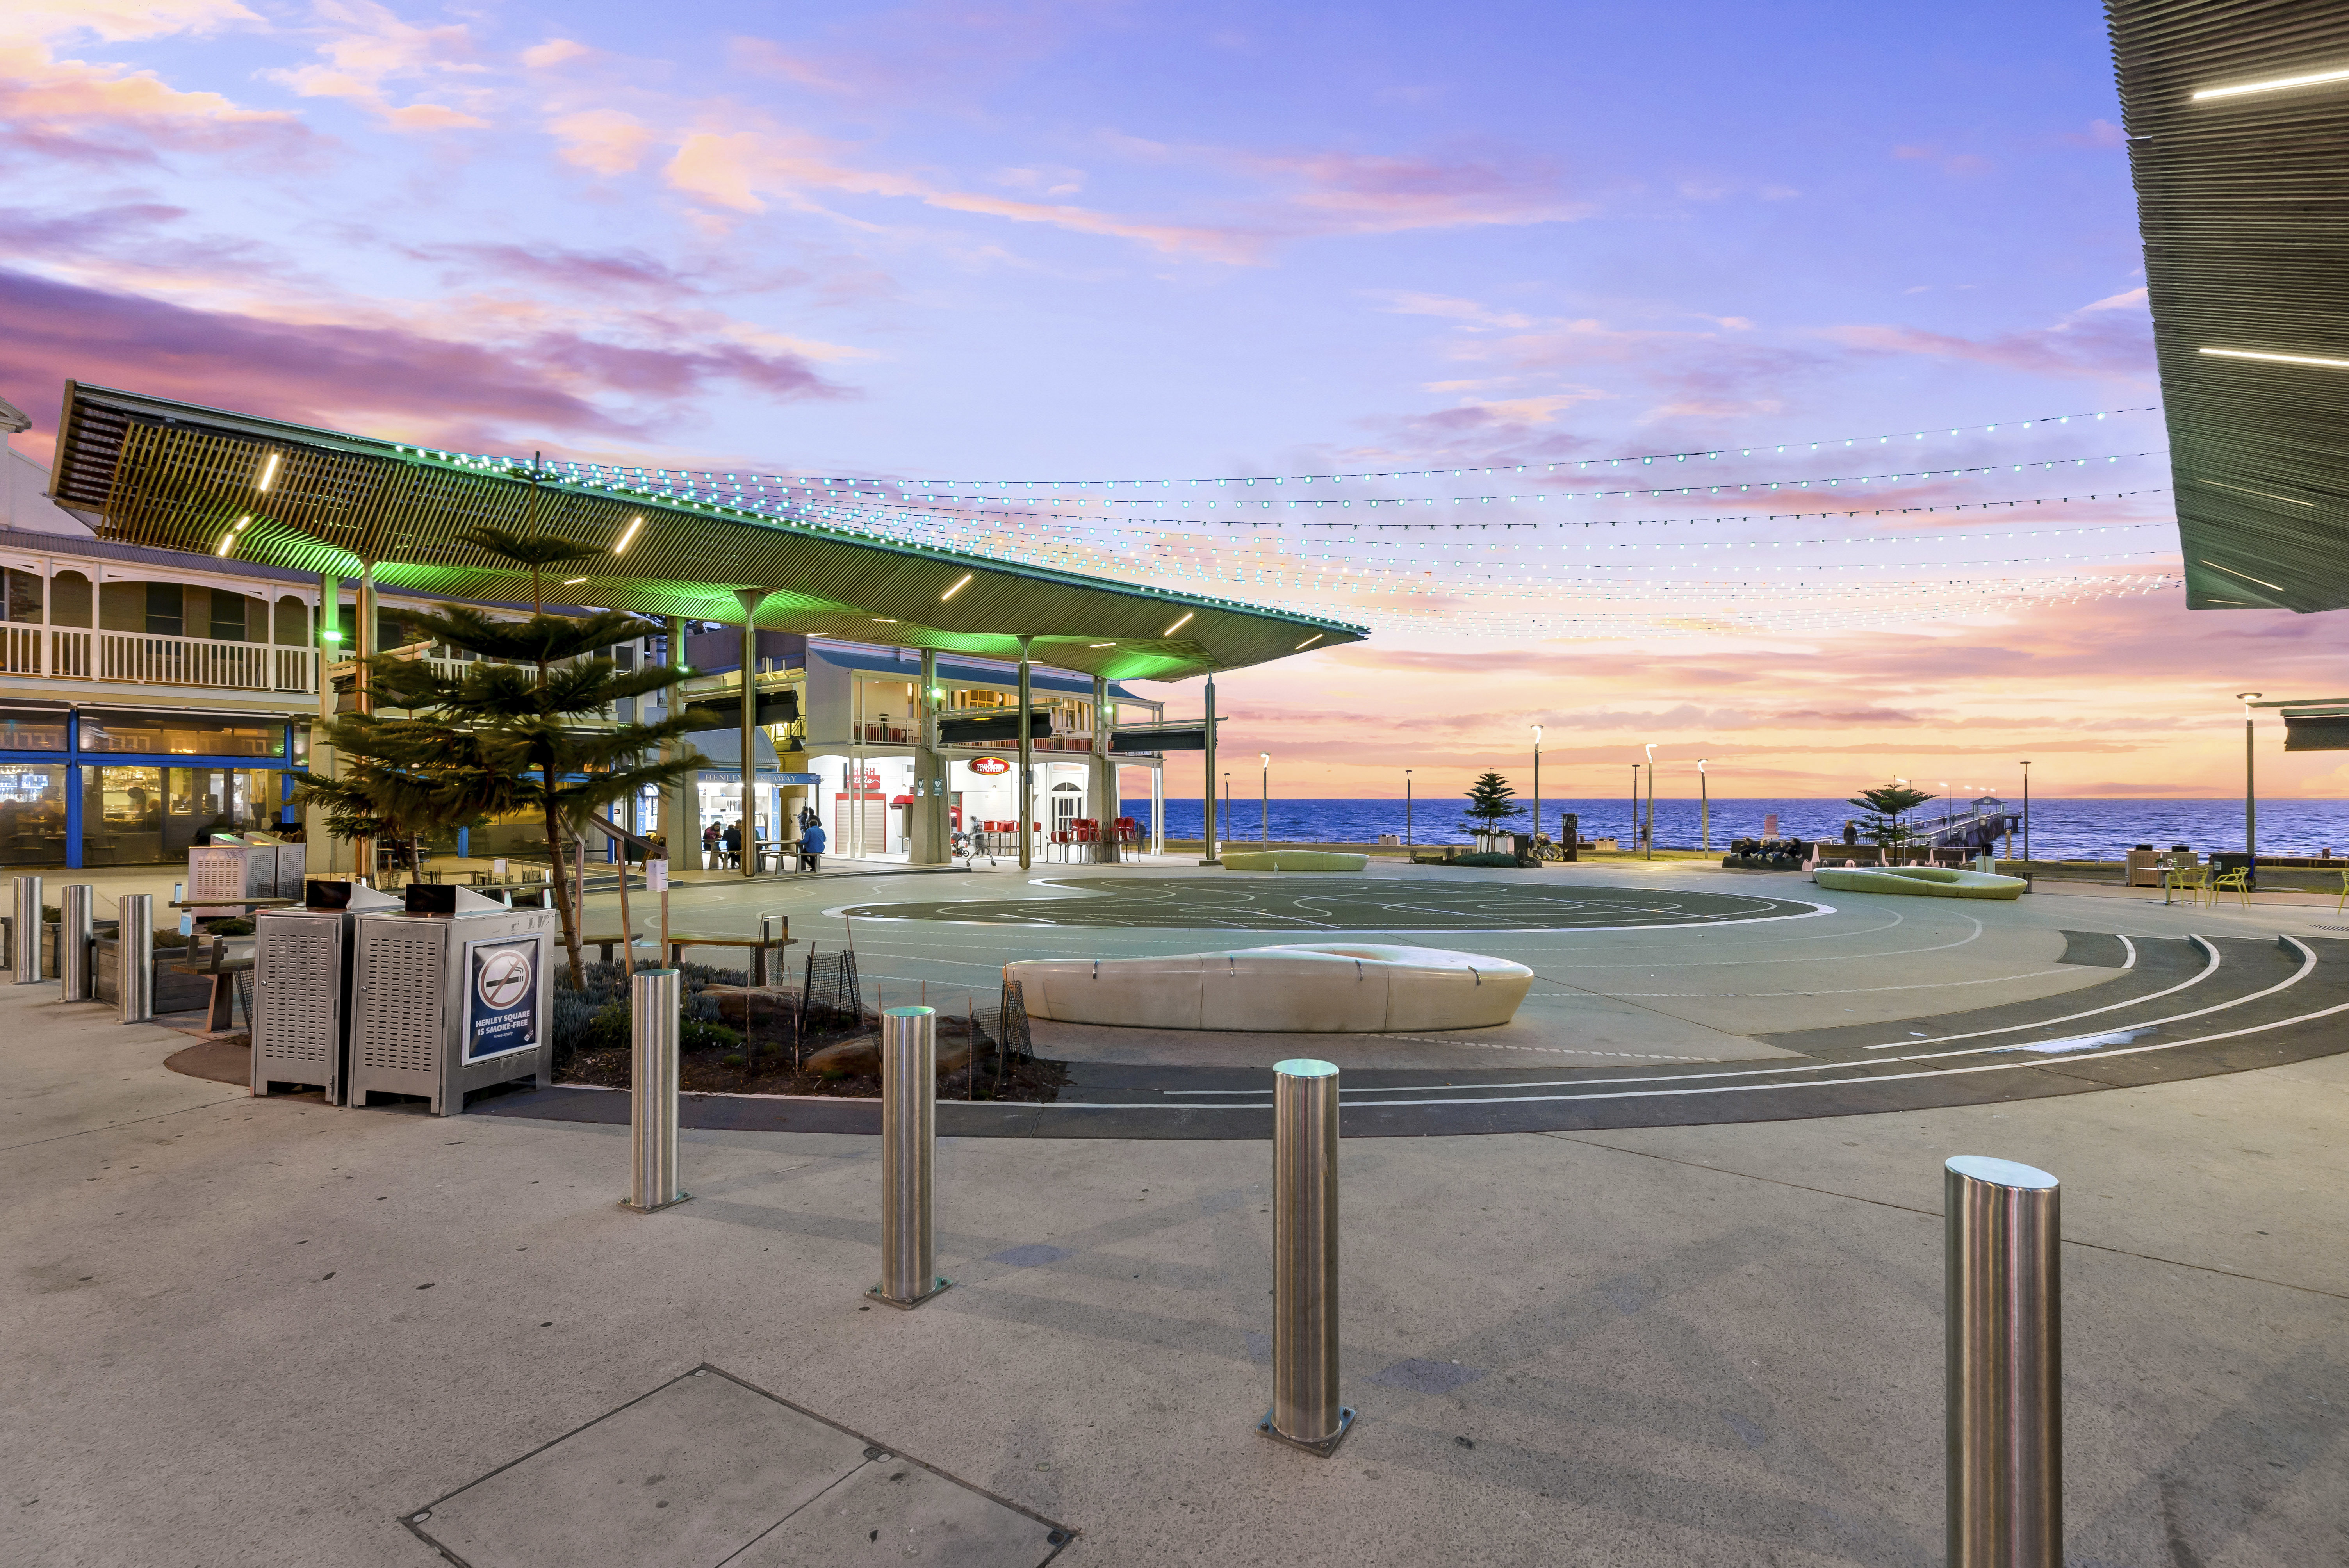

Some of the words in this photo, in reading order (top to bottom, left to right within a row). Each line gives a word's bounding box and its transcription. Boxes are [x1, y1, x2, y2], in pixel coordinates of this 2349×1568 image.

[476, 1016, 503, 1028] HENLEY
[504, 1010, 530, 1022] SQUARE
[486, 1019, 528, 1034] SMOKE-FREE
